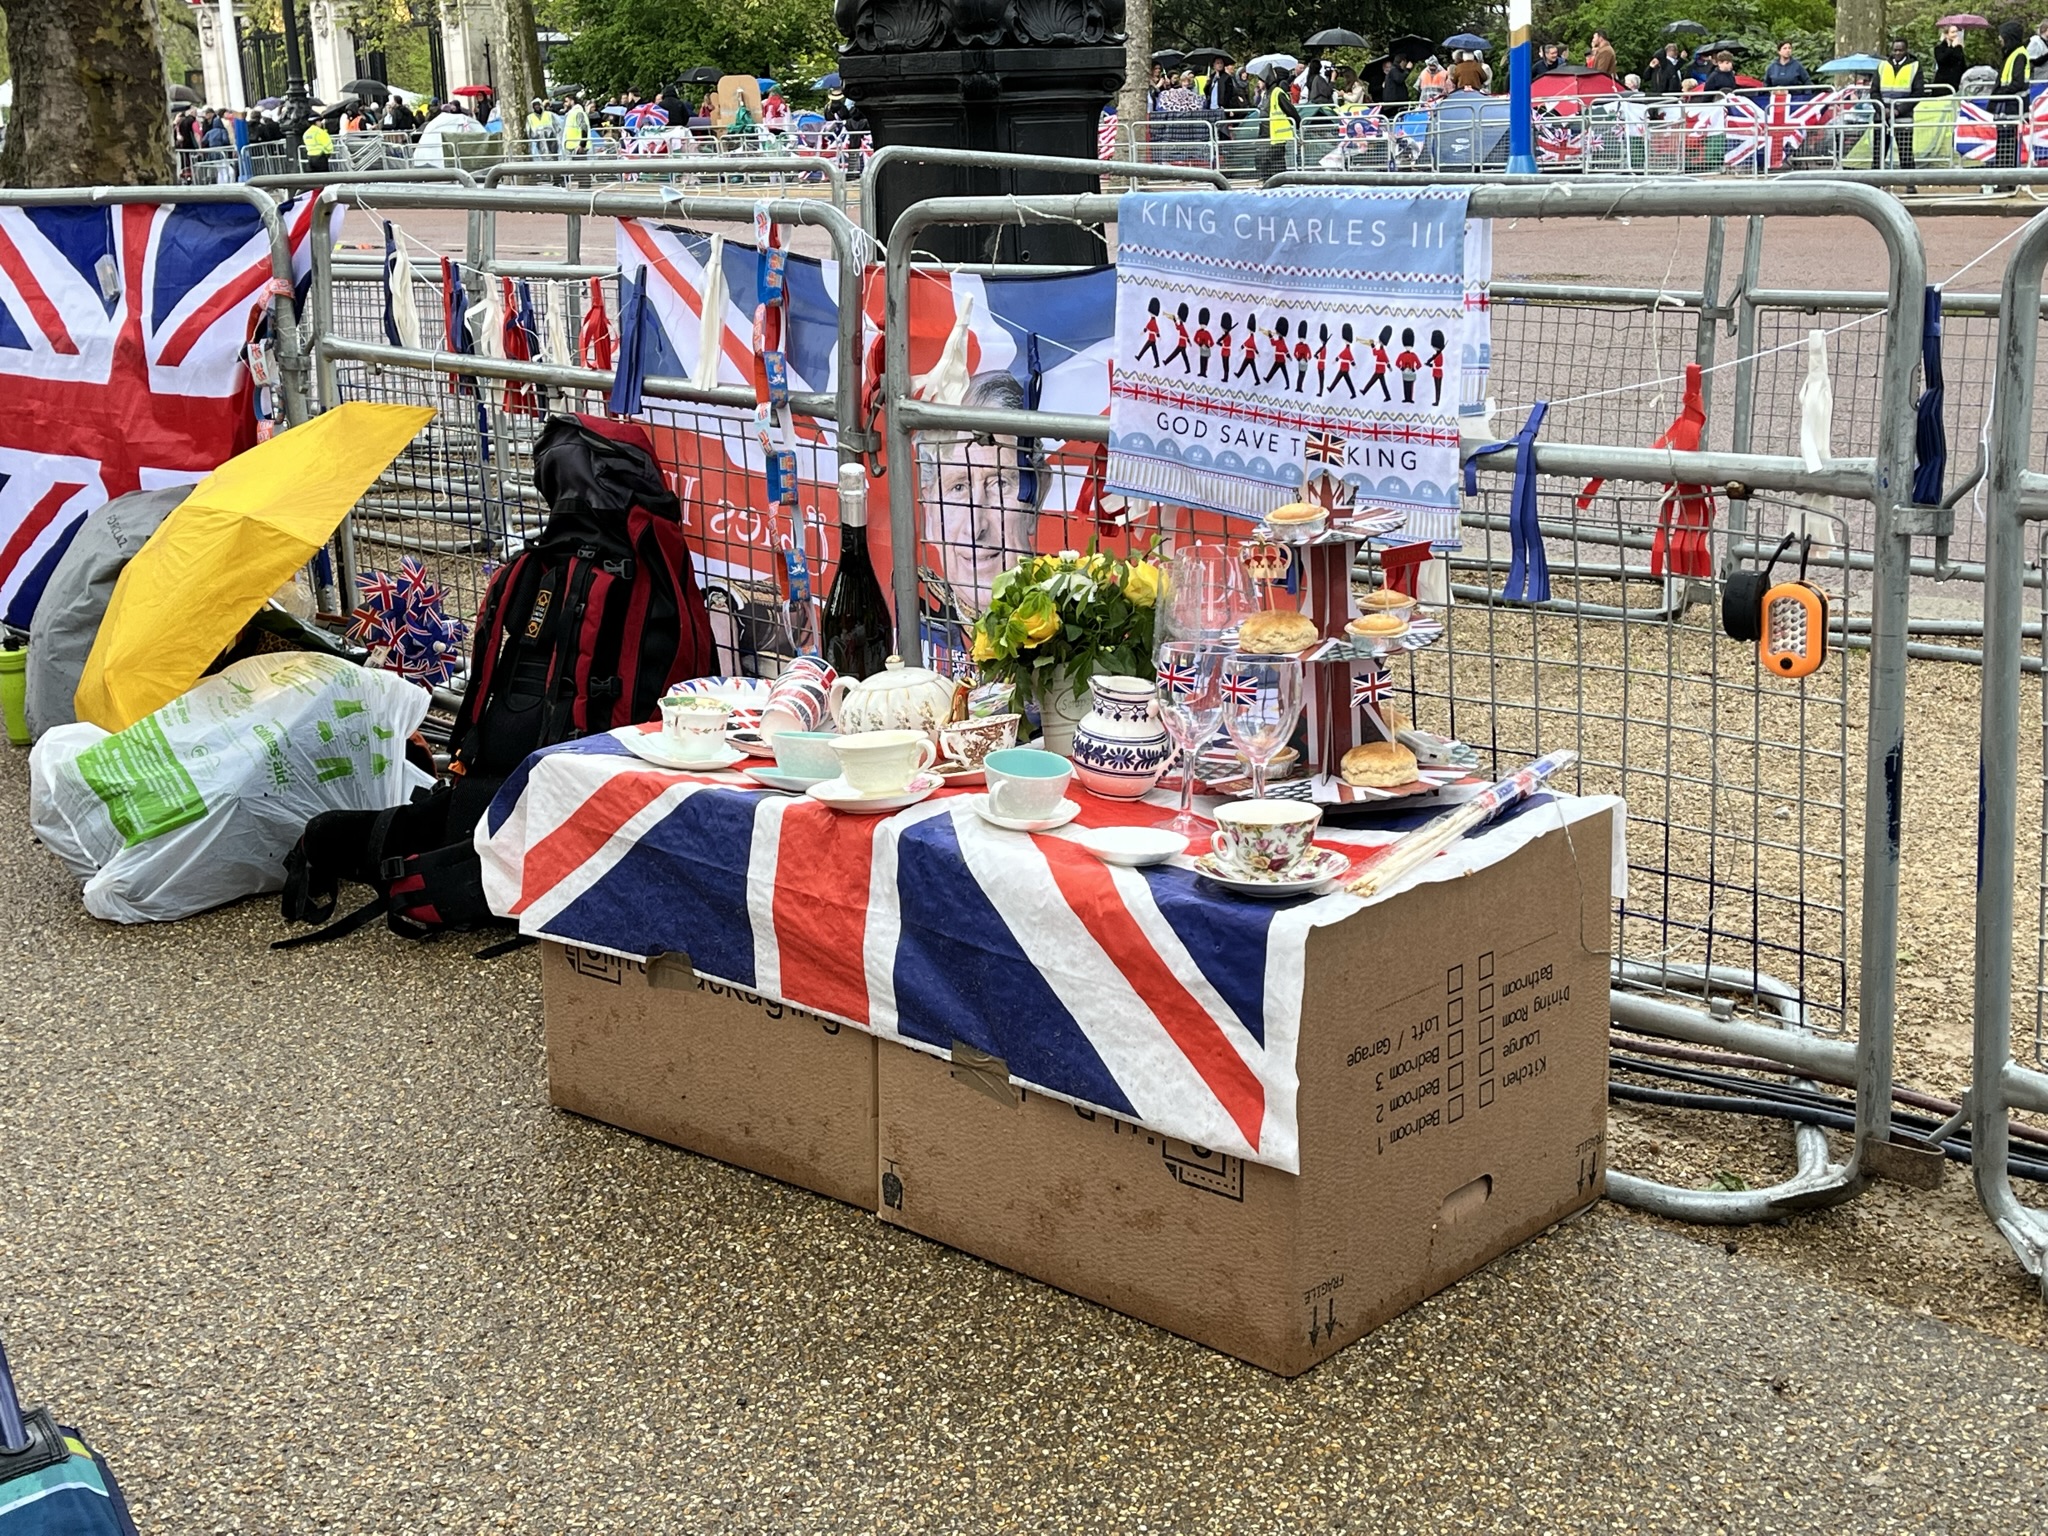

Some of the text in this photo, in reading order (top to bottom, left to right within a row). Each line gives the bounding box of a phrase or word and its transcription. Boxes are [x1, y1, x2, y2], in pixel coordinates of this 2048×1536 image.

[1142, 200, 1445, 248] KING CHARLES III
[1157, 412, 1208, 438] GOD
[1220, 425, 1279, 453] SAVE
[1346, 446, 1418, 471] KING
[105, 513, 128, 549] FORCLAZ
[253, 724, 280, 758] clothes
[273, 760, 289, 786] aid
[1502, 963, 1553, 998] Bathroom
[1502, 985, 1570, 1028] Dining Room
[1346, 1015, 1440, 1067] Loft / Garage
[1502, 1029, 1541, 1058] Lounge
[1375, 1046, 1440, 1092] Bedroom 3
[1502, 1056, 1547, 1088] Kitchen
[1375, 1077, 1440, 1123] Bedroom 2
[1376, 1109, 1440, 1156] Bedroom 1
[1574, 1131, 1606, 1158] FRAGILE
[1304, 1273, 1345, 1305] FRAGILE
